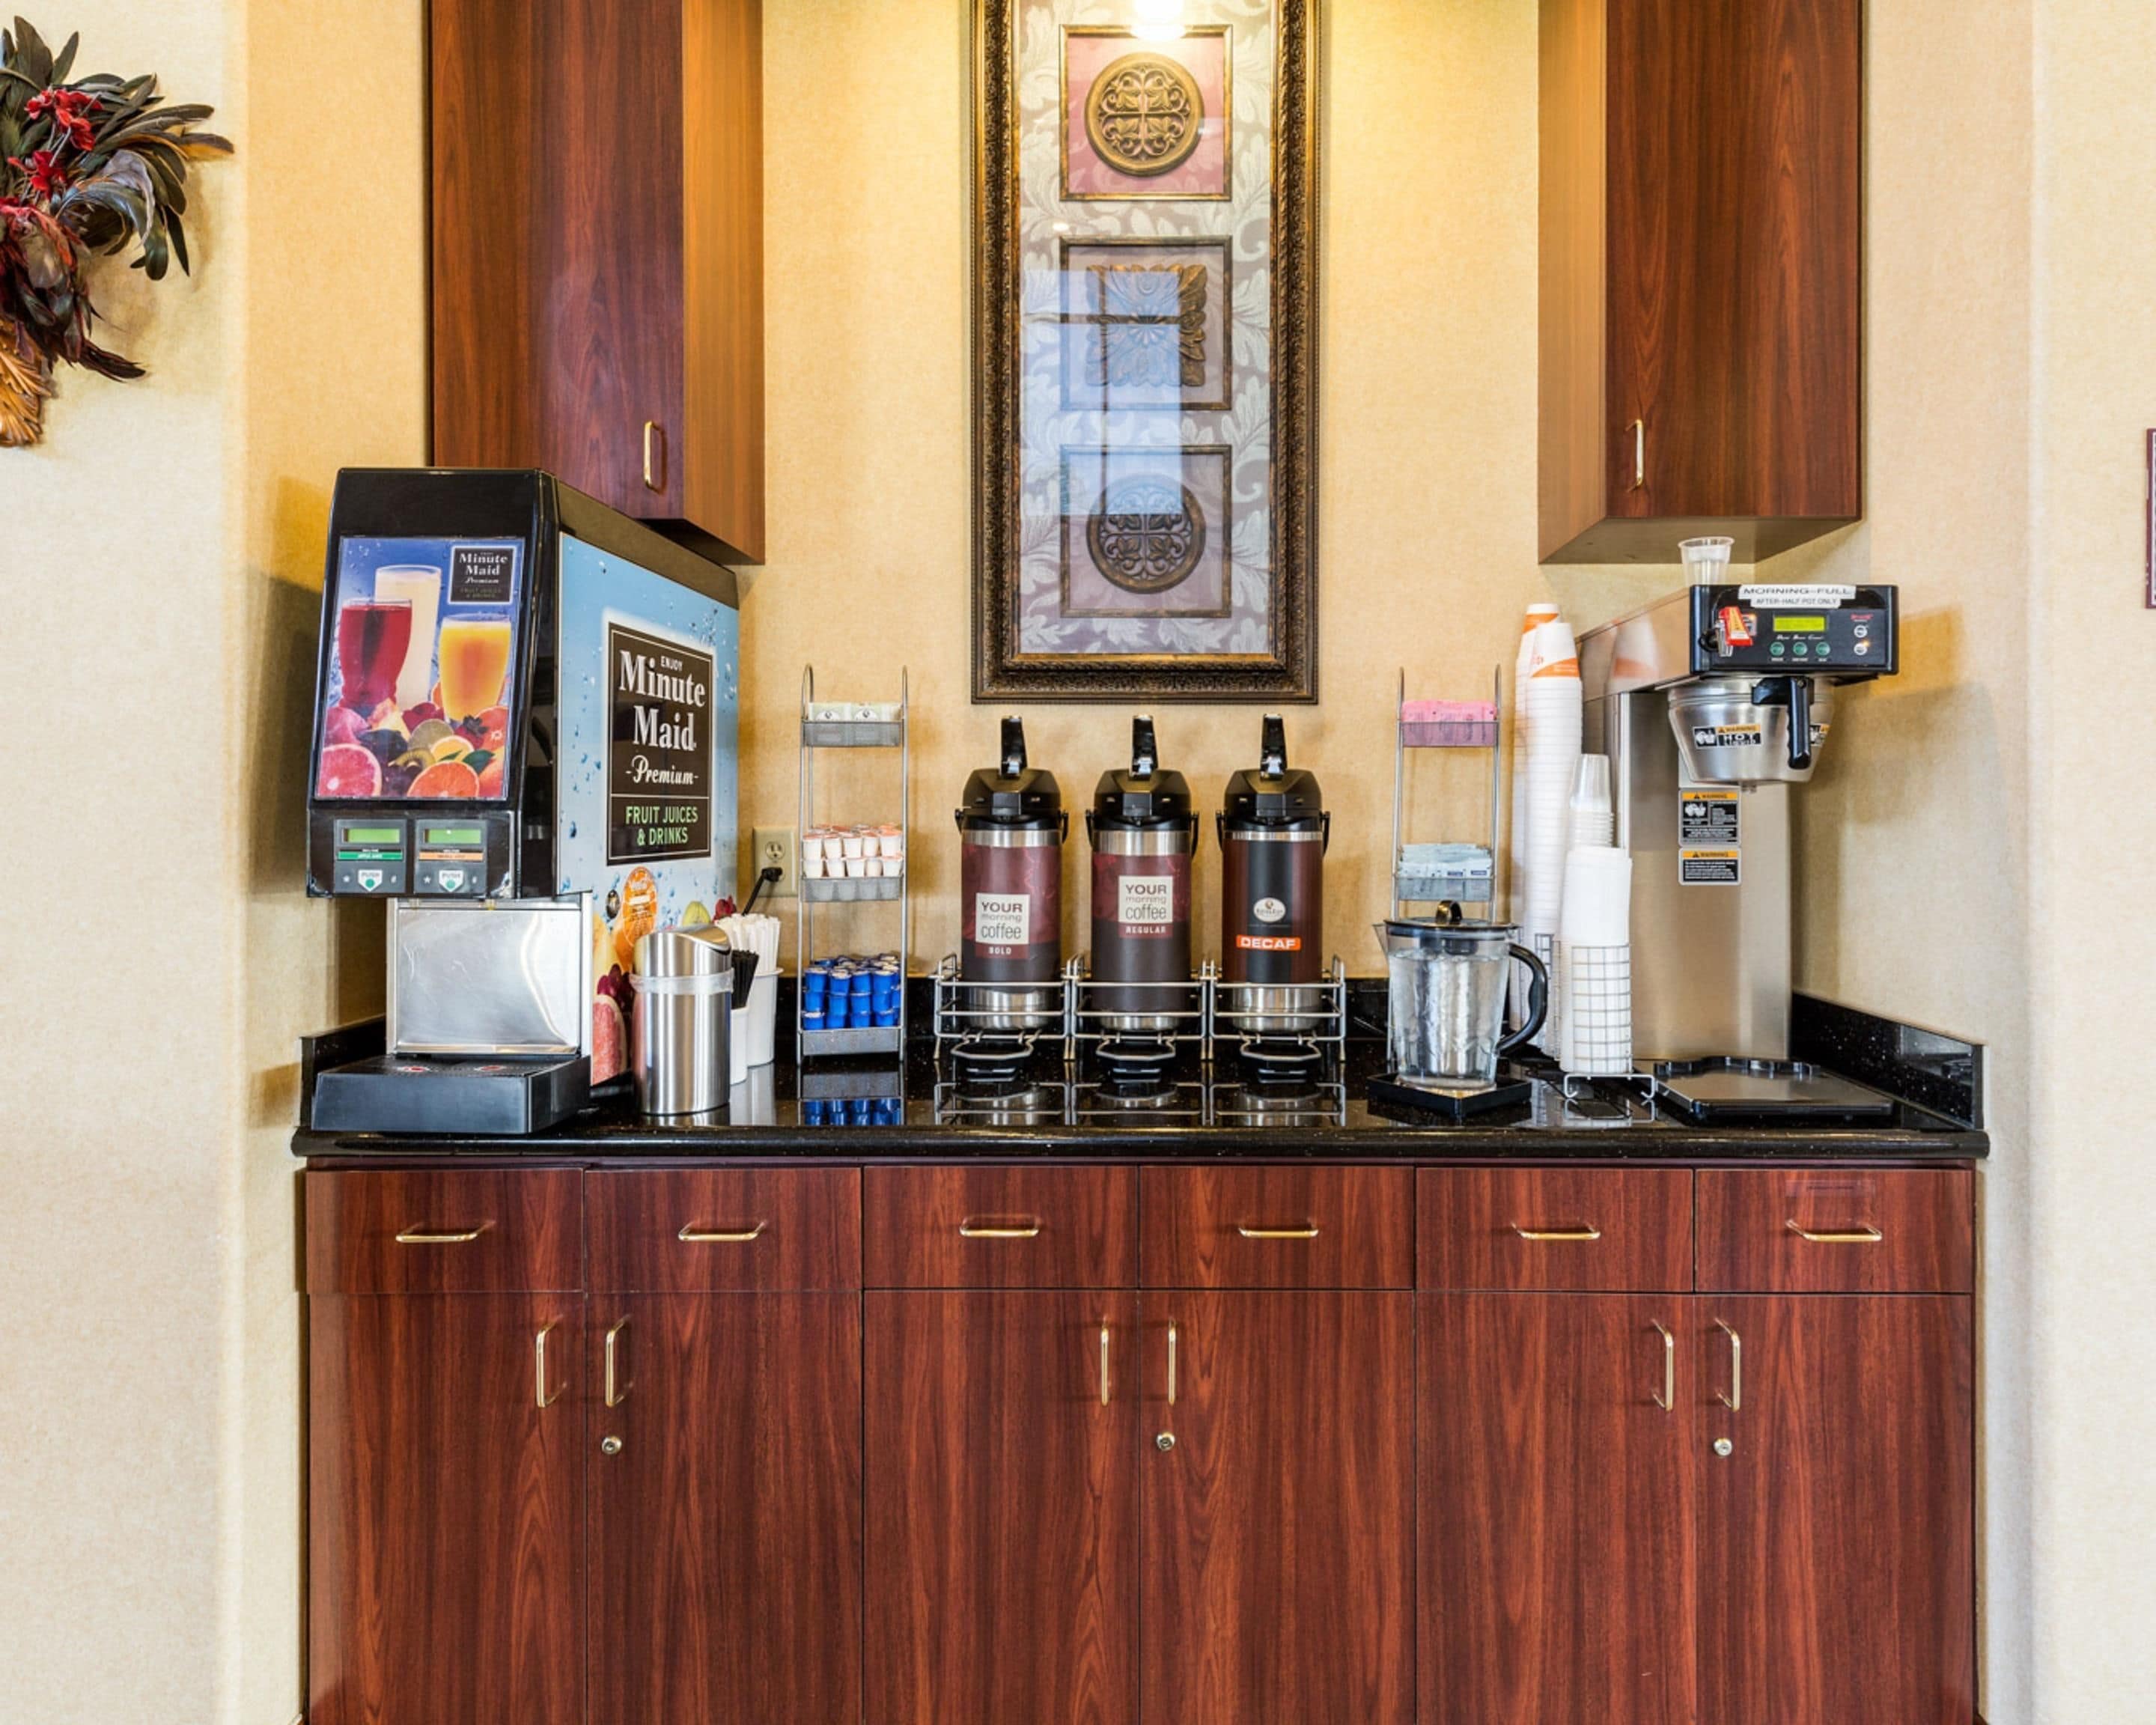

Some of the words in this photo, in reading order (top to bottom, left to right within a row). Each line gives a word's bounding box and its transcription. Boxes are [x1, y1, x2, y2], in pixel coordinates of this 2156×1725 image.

[459, 553, 508, 564] Minute
[466, 564, 500, 576] Maid
[660, 655, 683, 672] ENJOY
[618, 649, 706, 708] Minute
[632, 705, 695, 752] Maid
[624, 806, 660, 824] FRUIT
[663, 806, 699, 824] JUICES
[636, 828, 646, 846] &
[649, 827, 689, 845] DRINKS
[1126, 884, 1166, 895] YOUR
[981, 901, 1023, 913] YOUR
[1125, 904, 1166, 920] coffee
[981, 922, 1022, 939] coffee
[1125, 925, 1166, 934] REGULAR
[1240, 936, 1296, 950] DECAF
